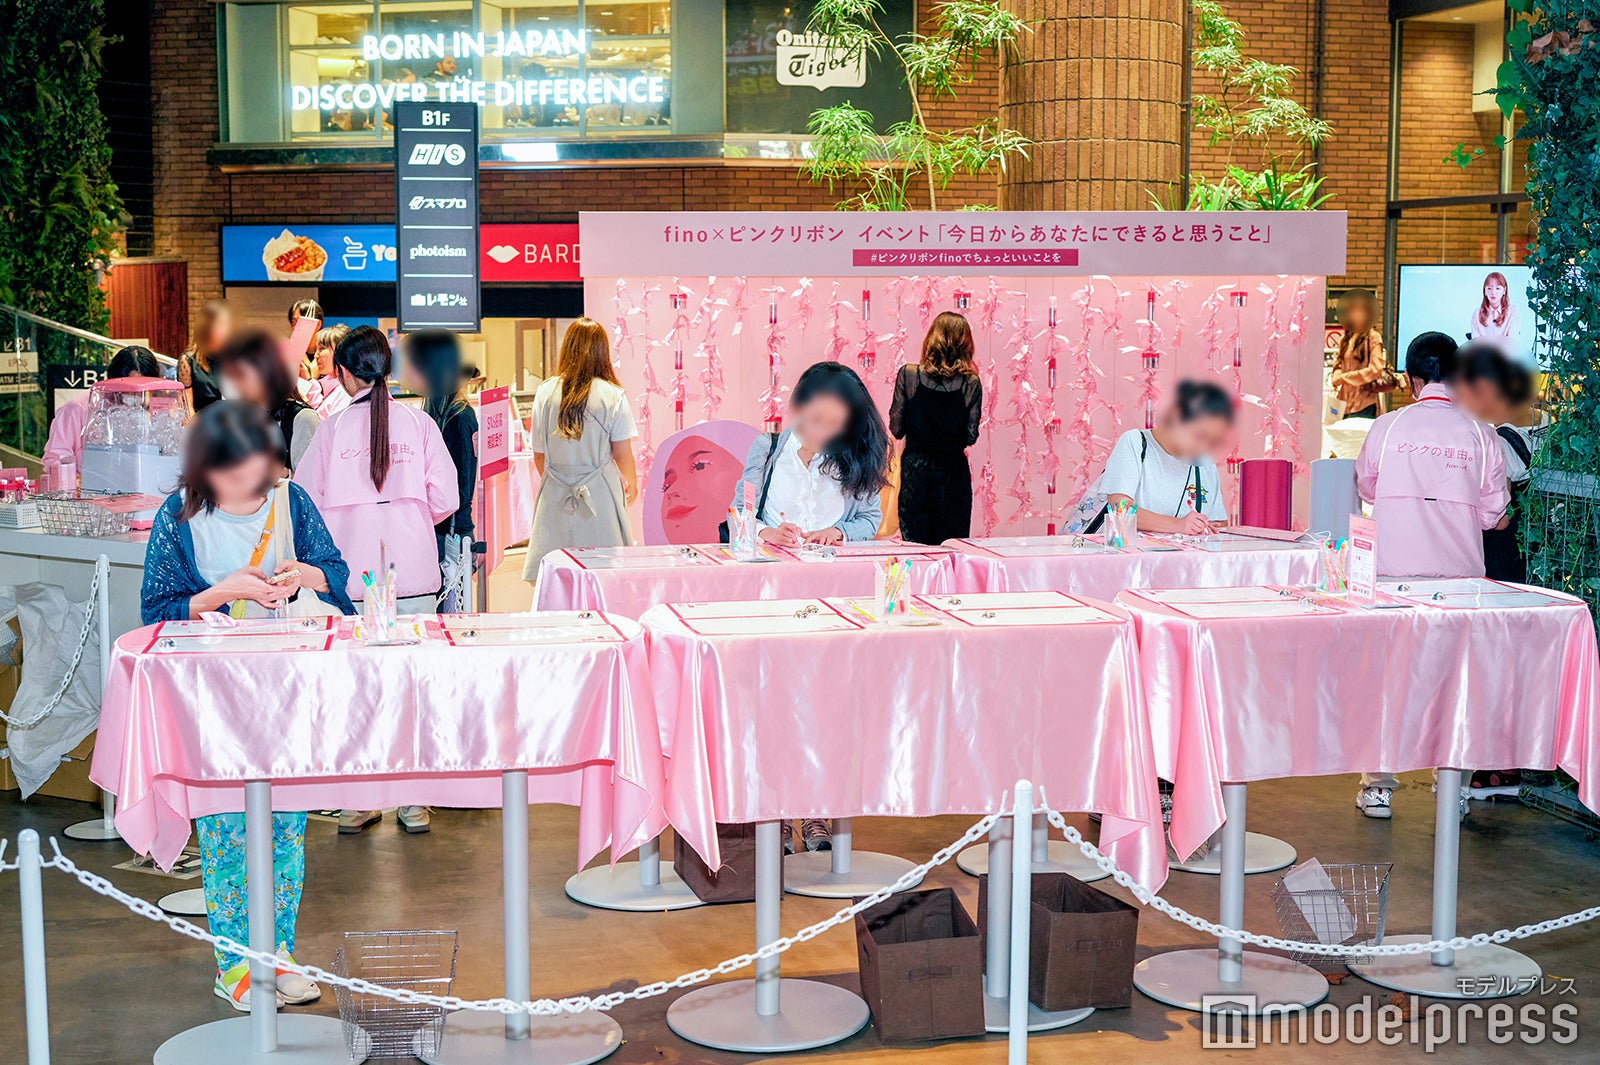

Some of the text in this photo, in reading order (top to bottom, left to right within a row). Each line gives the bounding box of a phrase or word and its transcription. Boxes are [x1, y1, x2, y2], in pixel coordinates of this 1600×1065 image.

[363, 29, 587, 60] BORN IN JAPAN
[789, 53, 847, 77] Tiger
[291, 76, 664, 110] DISCOVER THE DIFFERENCE
[422, 110, 450, 126] B1F
[858, 223, 1271, 244] イベント「今日からあなたにできると思うこと」
[410, 244, 467, 259] photoism
[870, 251, 1061, 265] #ピンクリボンfinoでちょっといいことを
[1397, 443, 1473, 462] ピンクの理由。
